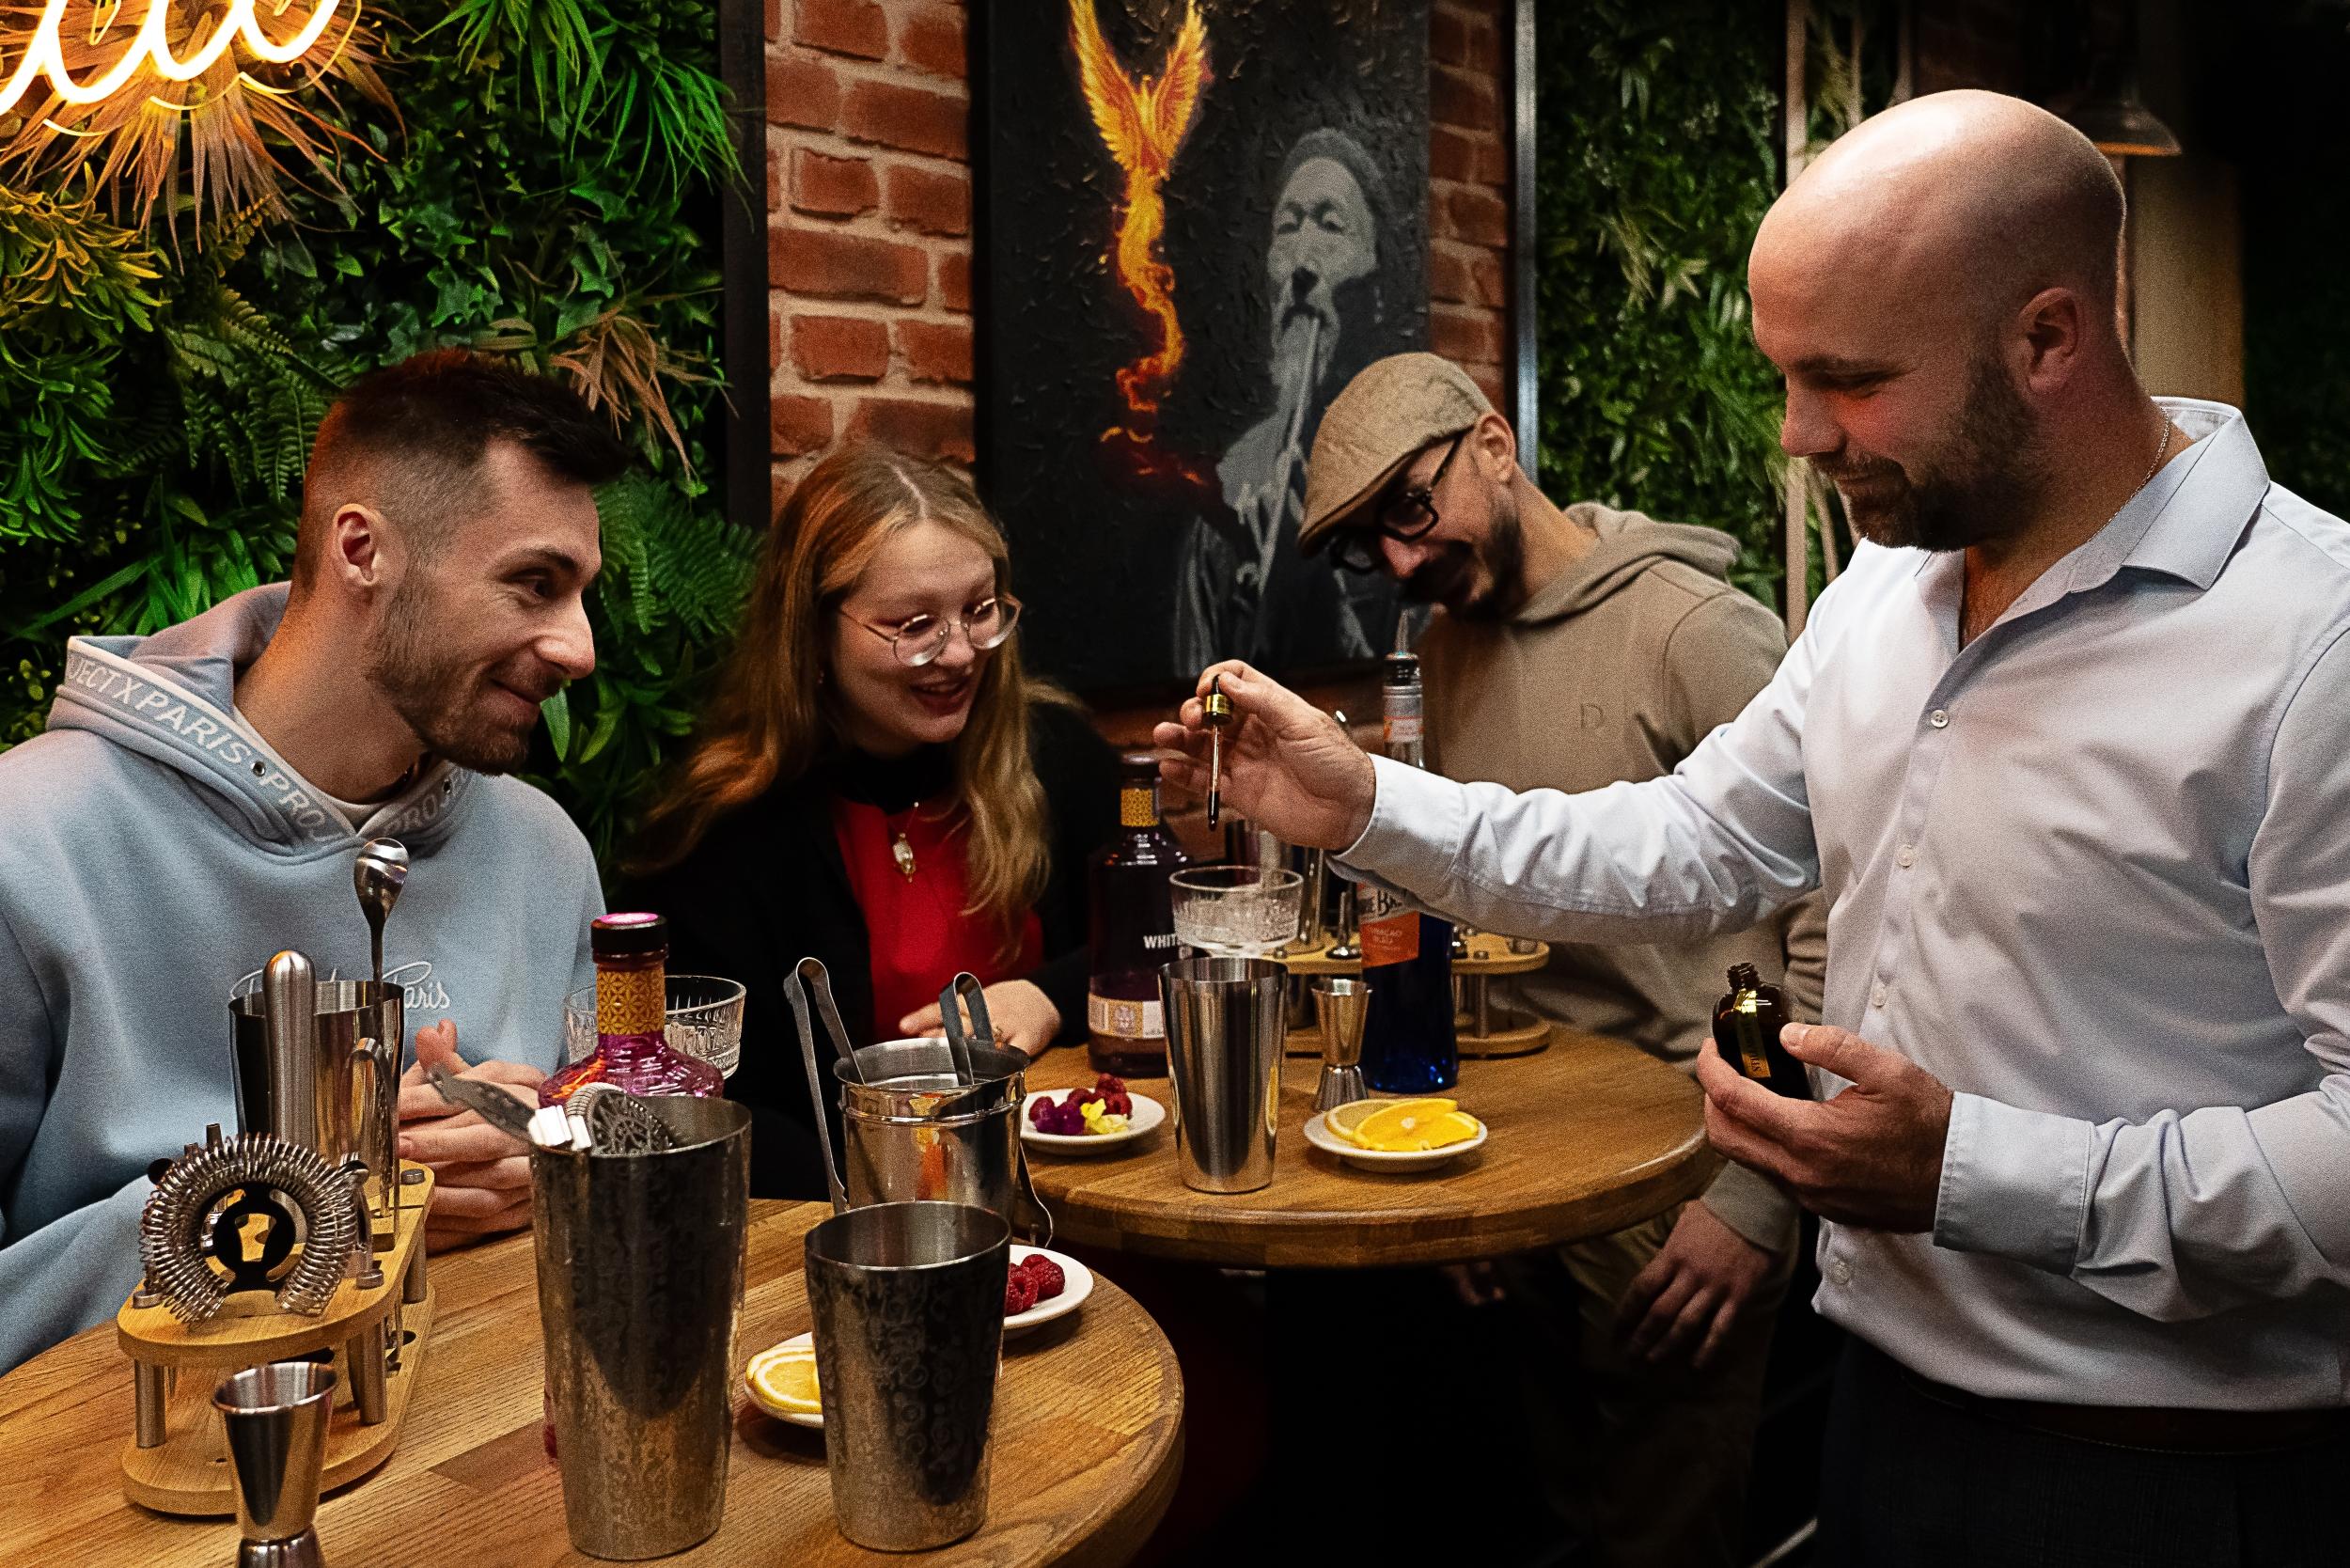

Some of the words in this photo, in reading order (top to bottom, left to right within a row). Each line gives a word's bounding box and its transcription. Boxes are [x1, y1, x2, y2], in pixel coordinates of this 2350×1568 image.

[69, 654, 122, 693] JECT
[112, 676, 144, 705] X
[134, 691, 251, 765] PARIS
[1143, 933, 1183, 949] WHIT
[382, 961, 450, 1011] Paris
